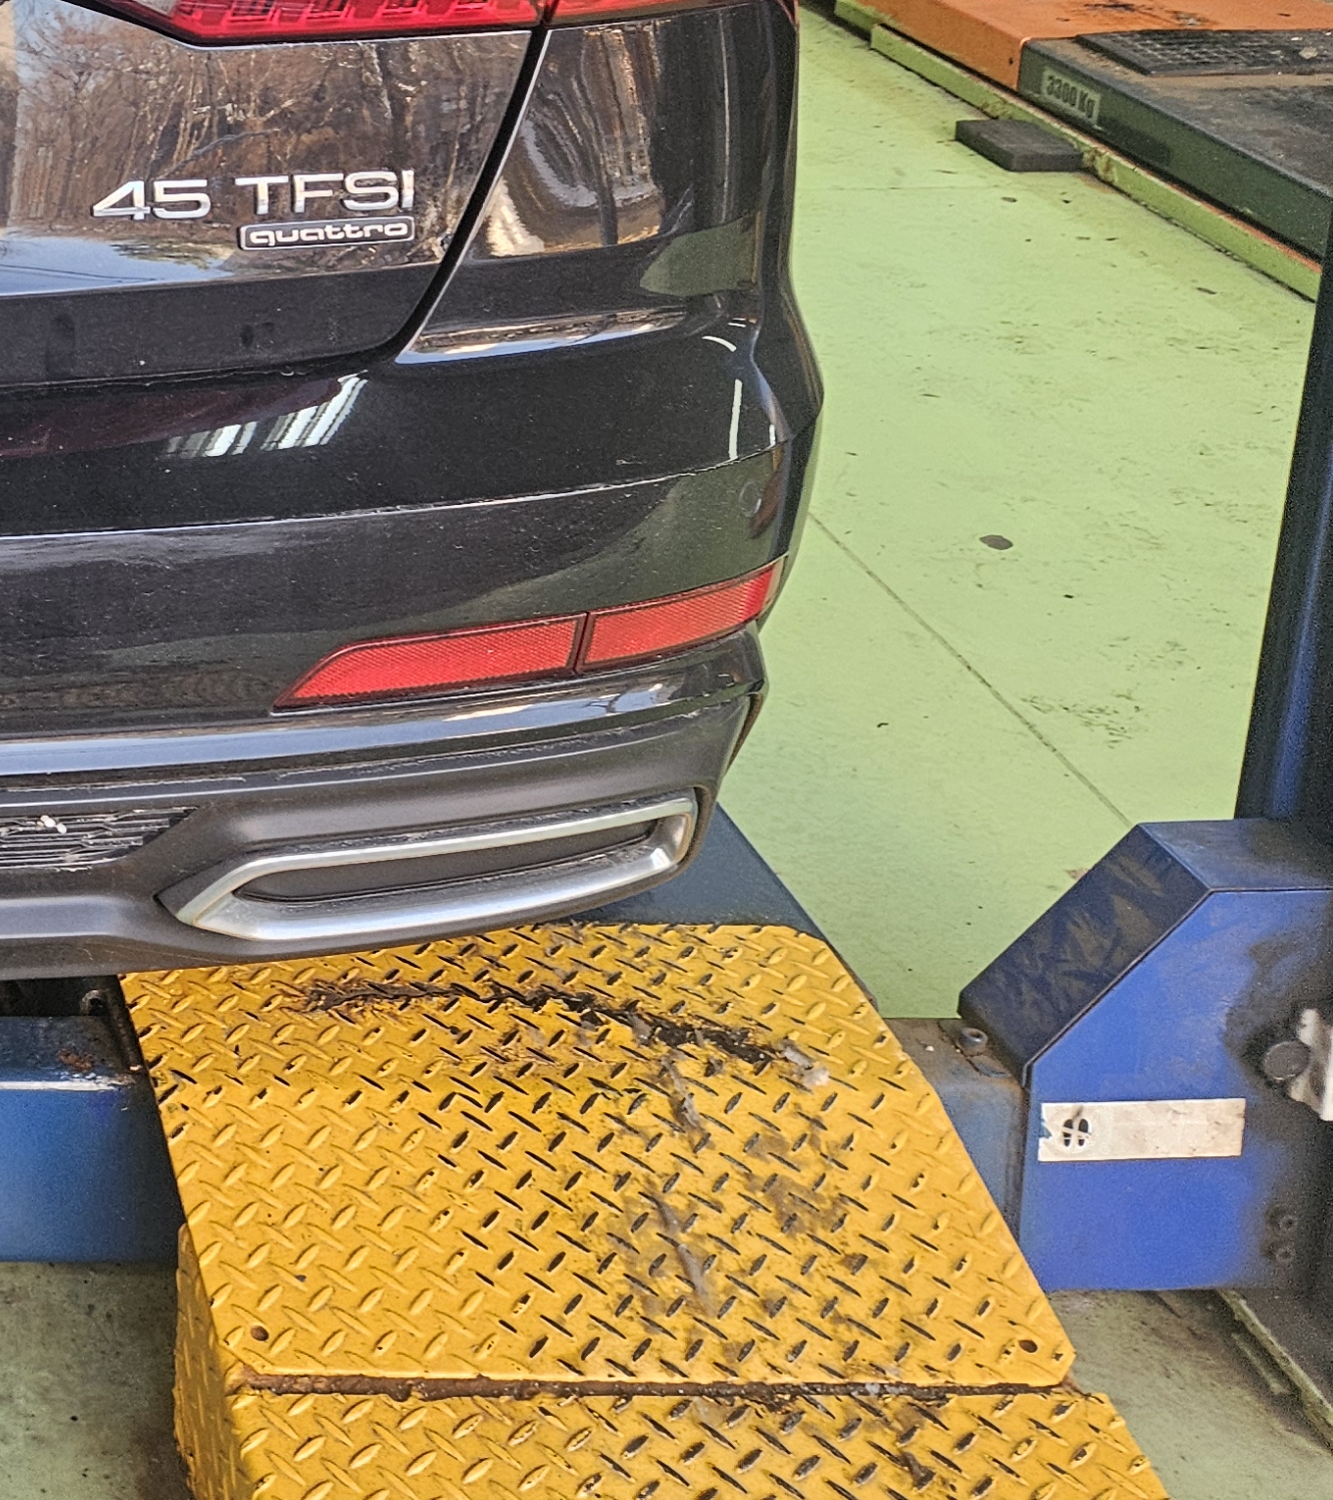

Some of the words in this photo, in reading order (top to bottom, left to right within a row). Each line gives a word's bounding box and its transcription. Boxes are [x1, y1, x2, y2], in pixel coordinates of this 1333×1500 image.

[92, 179, 212, 220] 45
[234, 169, 415, 215] TFSI
[248, 221, 408, 248] quattro
